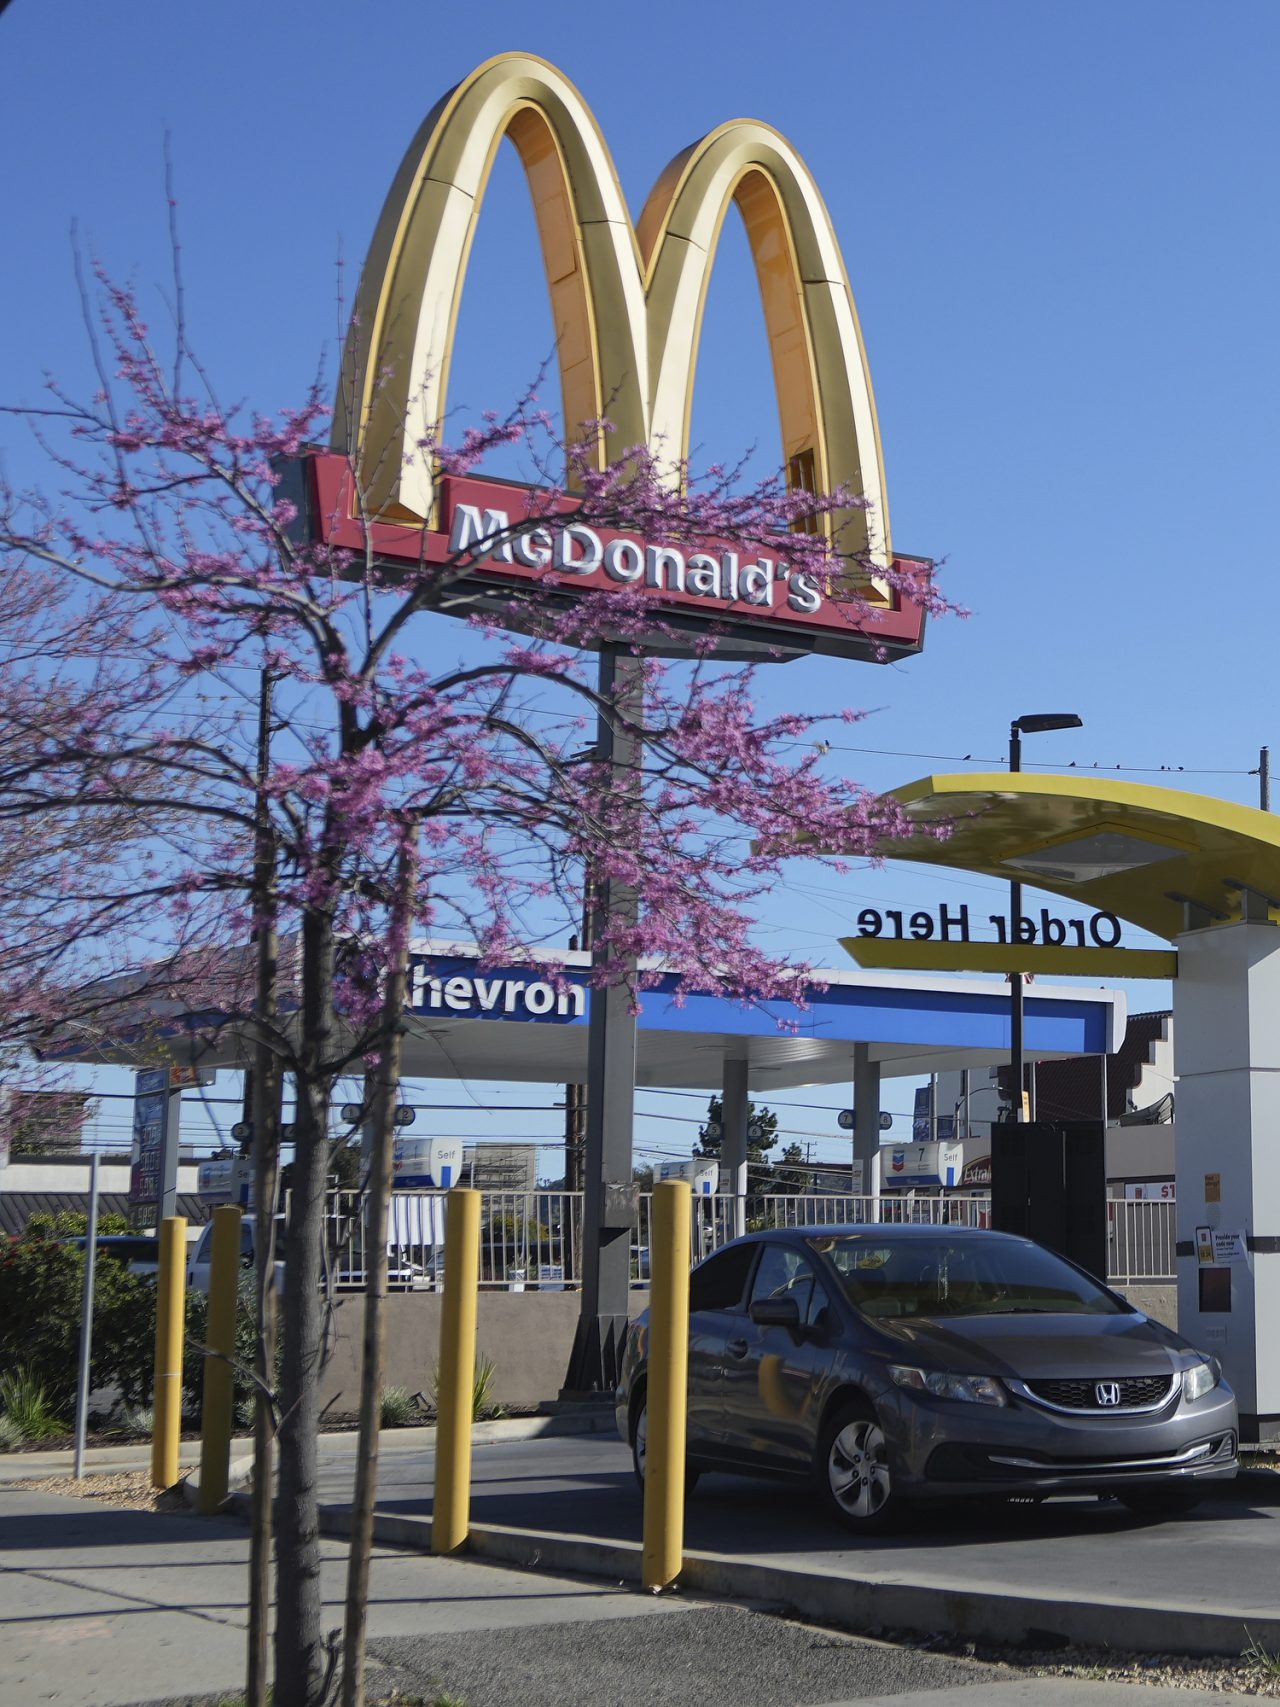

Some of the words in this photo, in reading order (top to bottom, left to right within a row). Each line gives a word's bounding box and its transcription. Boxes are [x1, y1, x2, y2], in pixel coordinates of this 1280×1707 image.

[437, 1150, 456, 1160] Self
[918, 1147, 926, 1162] 7
[943, 1153, 958, 1162] Self
[699, 1168, 713, 1177] Self
